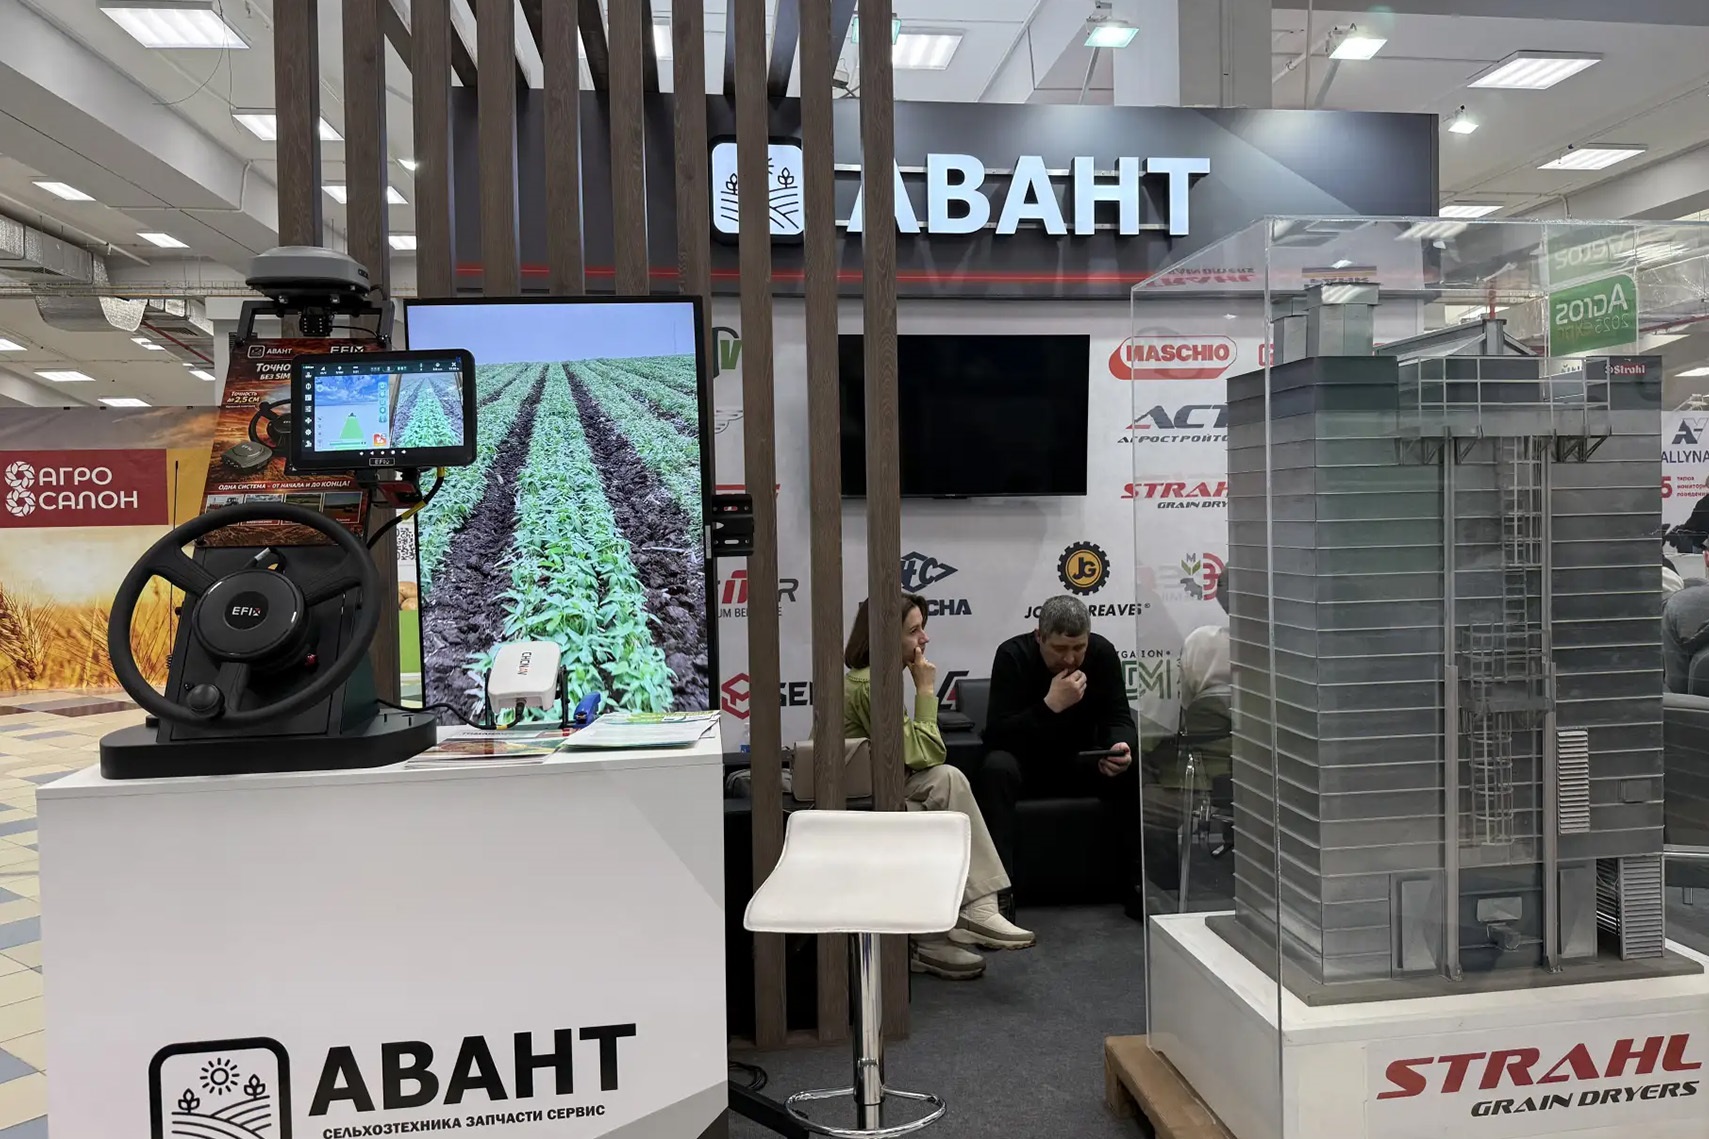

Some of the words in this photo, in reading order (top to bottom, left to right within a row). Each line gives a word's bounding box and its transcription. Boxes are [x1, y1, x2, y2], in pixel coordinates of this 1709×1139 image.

[1126, 343, 1230, 362] MASCHIO
[256, 363, 292, 372] ТОЧНО
[1117, 433, 1228, 444] АГРОСТРОЙТО
[38, 466, 113, 486] АГРО
[38, 490, 138, 510] САЛОН
[1121, 481, 1228, 499] STRAH
[1157, 501, 1200, 509] GRAIN
[1201, 500, 1228, 508] DRY
[308, 1023, 637, 1117] АВАНТ
[1376, 1033, 1703, 1100] STRAHL
[1471, 1092, 1574, 1118] GRAIN
[1577, 1080, 1700, 1107] DRYERS
[323, 1118, 462, 1139] СЕЛЬХОЗТЕХНИКА
[466, 1110, 543, 1127] ЗАПЧАСТИ
[547, 1104, 605, 1120] СЕРВИС
